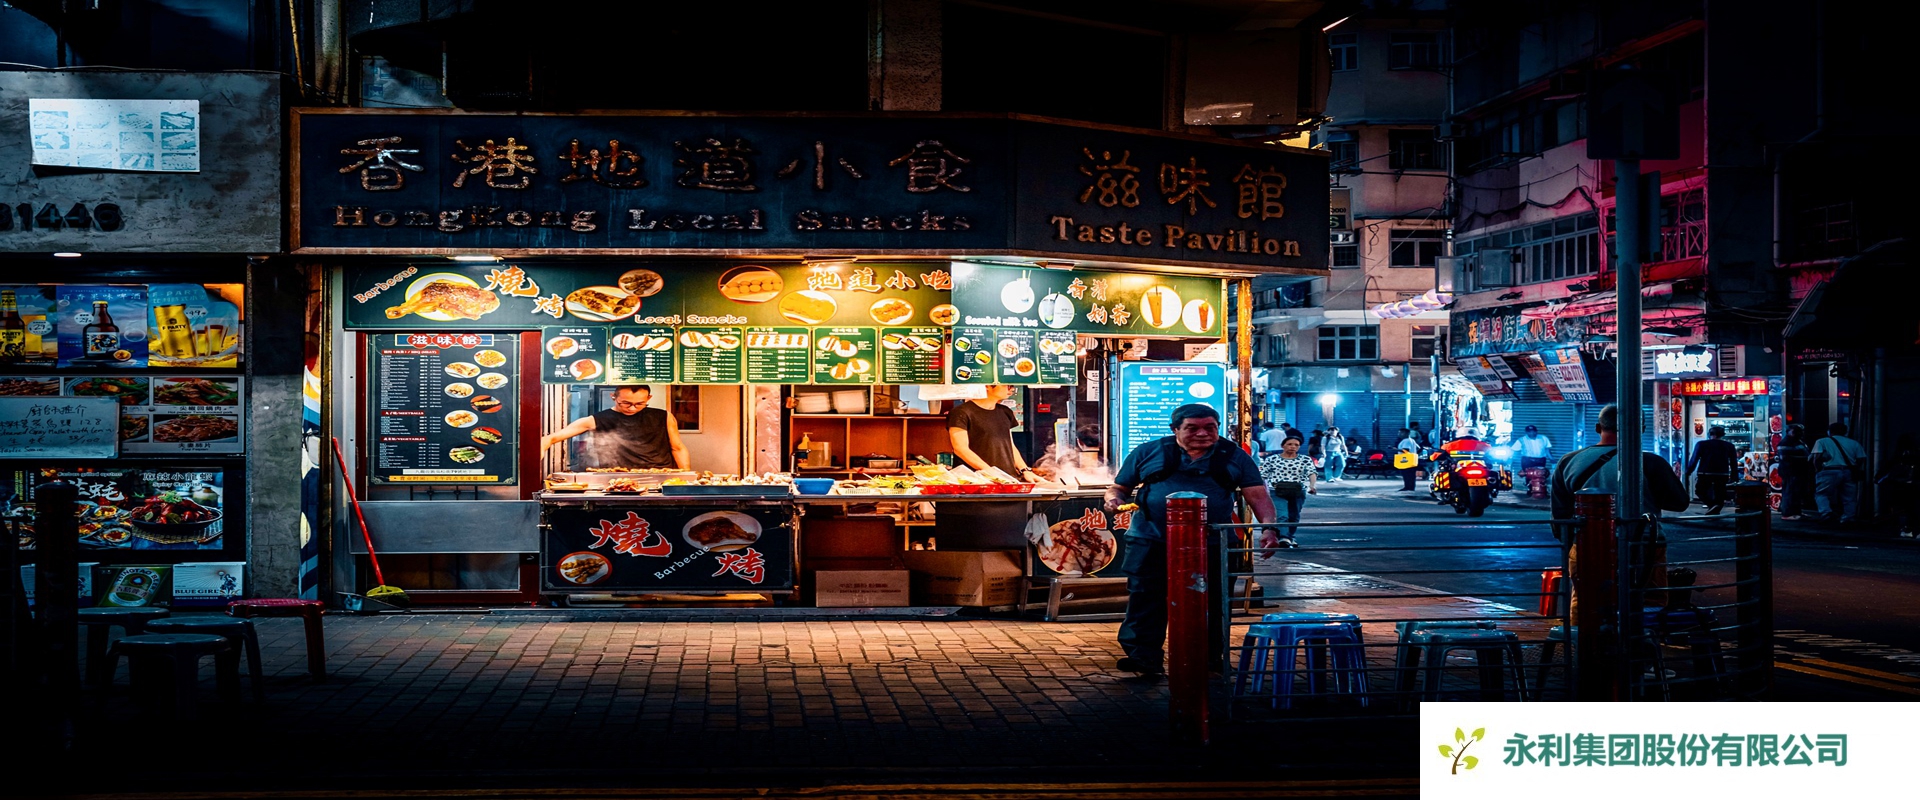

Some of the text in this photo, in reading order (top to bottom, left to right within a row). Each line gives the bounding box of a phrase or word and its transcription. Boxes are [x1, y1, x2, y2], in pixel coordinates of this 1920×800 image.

[339, 136, 970, 192] 香港地道小食
[1079, 146, 1288, 222] 滋味館
[628, 208, 764, 231] Local
[796, 208, 971, 231] Snacks
[1051, 215, 1302, 258] Taste Pavilion
[353, 265, 418, 303] Barbecue
[806, 267, 953, 292] 地道小吃
[634, 314, 748, 325] Local Snacks
[412, 334, 479, 346] 滋味館
[116, 568, 152, 582] TSINGTAO
[653, 545, 711, 580] Barbecue
